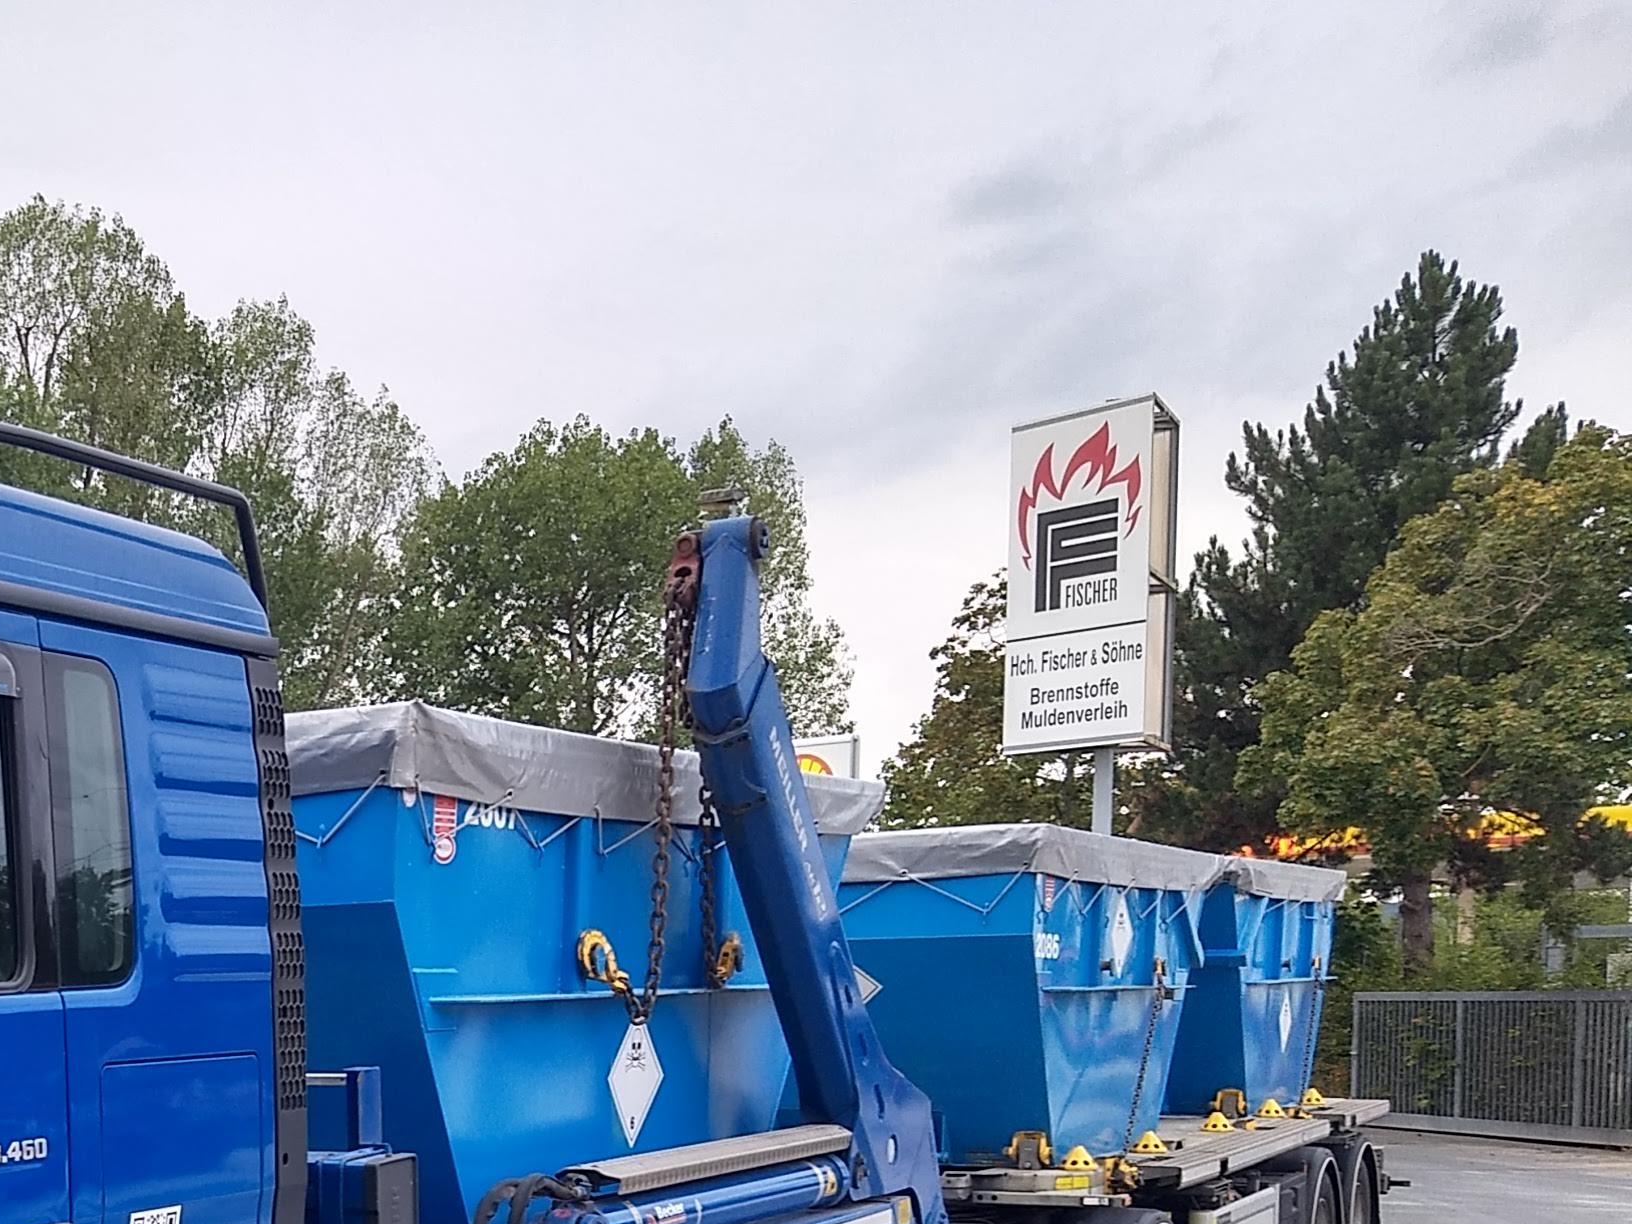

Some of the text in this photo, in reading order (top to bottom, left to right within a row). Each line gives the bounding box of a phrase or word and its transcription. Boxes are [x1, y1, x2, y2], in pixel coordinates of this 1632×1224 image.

[1065, 577, 1117, 608] FISCHER
[1010, 640, 1143, 677] Hch. Fischer & Söhne
[1030, 678, 1119, 705] Brennstoffe
[1021, 701, 1128, 729] Muldenverleih
[1035, 932, 1060, 959] 2086
